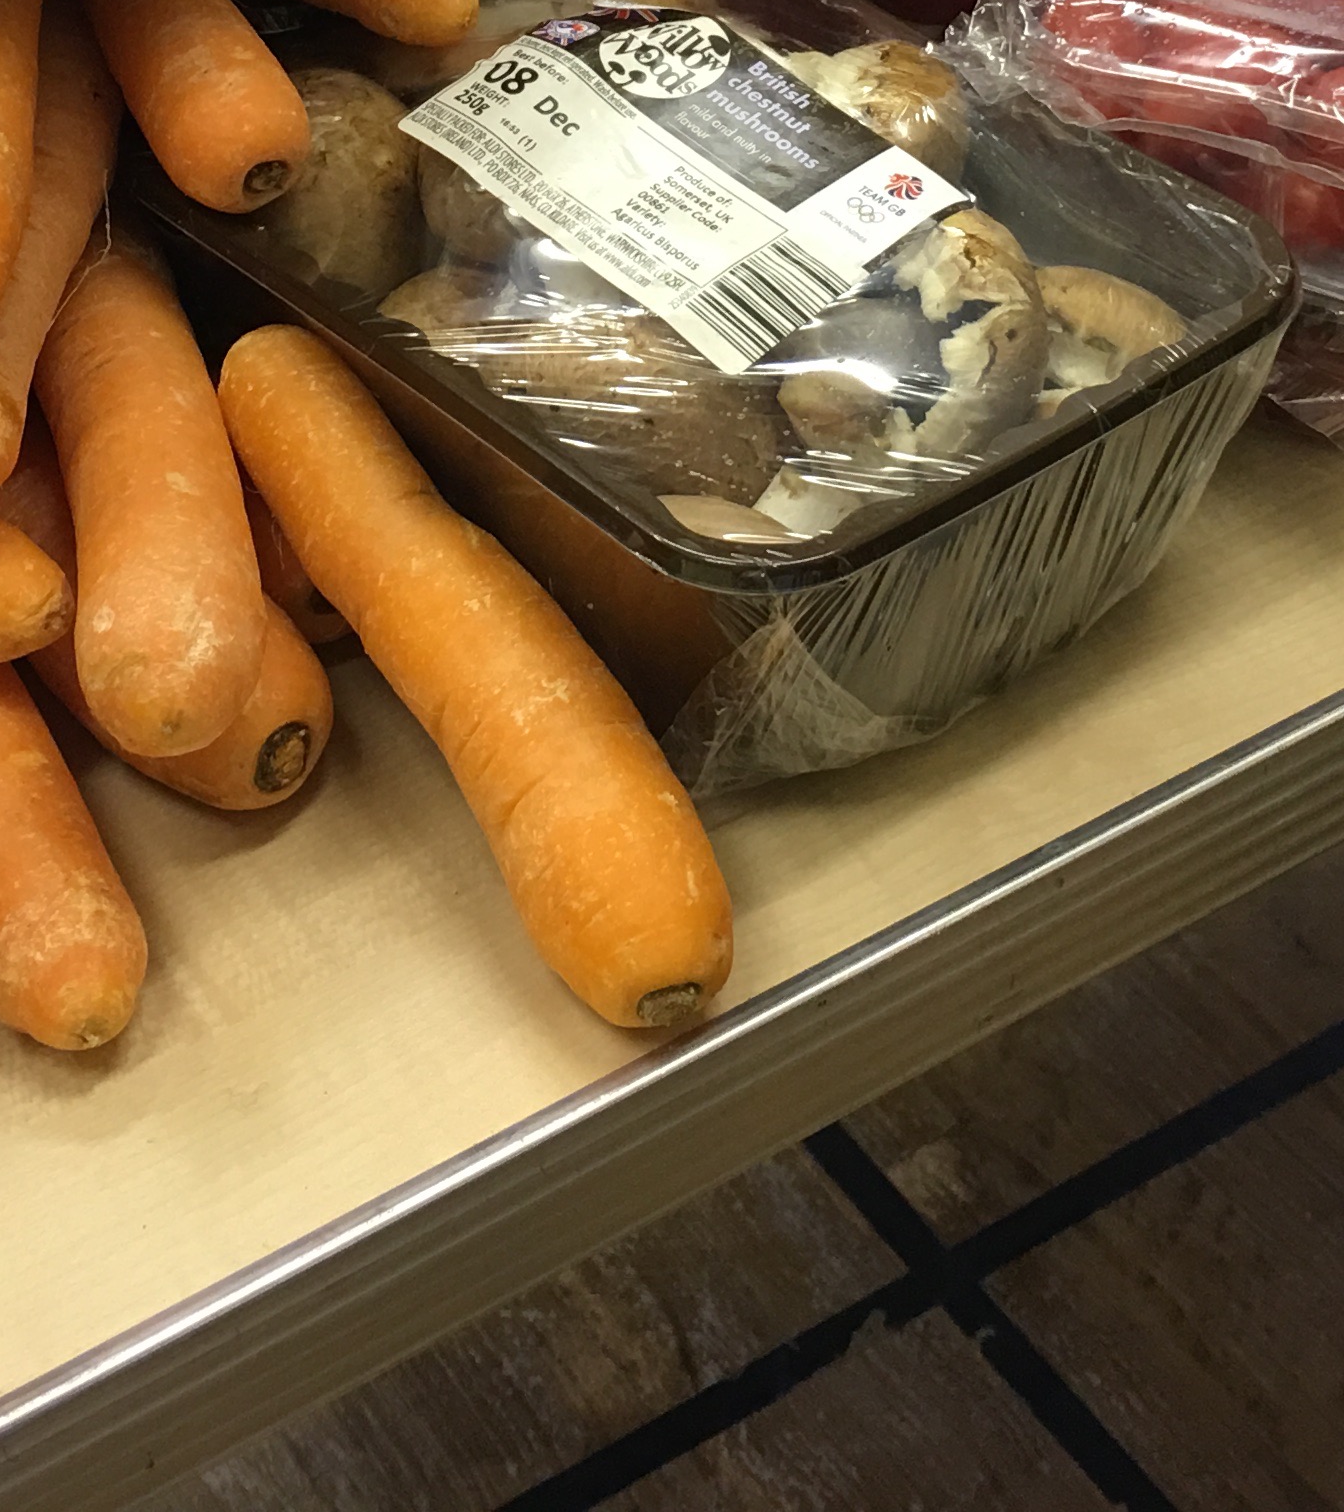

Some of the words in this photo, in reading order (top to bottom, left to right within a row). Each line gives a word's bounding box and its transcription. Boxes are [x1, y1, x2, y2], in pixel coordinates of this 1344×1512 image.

[513, 47, 537, 64] Best
[532, 56, 572, 84] before:
[633, 23, 723, 70] Willow
[469, 80, 512, 109] WEIGHT:
[481, 54, 541, 99] 08
[529, 95, 586, 136] Dec
[725, 74, 814, 136] chestnut
[745, 59, 815, 110] British
[451, 87, 492, 117] 250g
[515, 135, 539, 152] (1)
[672, 110, 714, 140] flavour
[688, 103, 716, 124] mild
[710, 119, 737, 139] and
[730, 134, 763, 158] nutty
[703, 86, 824, 170] mushrooms
[480, 138, 503, 156] ALDI
[494, 151, 527, 176] STORES
[603, 232, 659, 271] WARWICKSHIRE
[635, 191, 671, 214] 00861
[660, 175, 715, 212] Somerset,
[713, 209, 734, 224] UK
[672, 166, 719, 197] Produce
[858, 185, 887, 206] TEAM
[886, 202, 906, 217] GB
[491, 167, 512, 183] BOX
[515, 187, 542, 208] NAAS,
[572, 228, 593, 245] Visit
[601, 251, 654, 289] www.aldi.com
[624, 199, 668, 228] Variety:
[647, 183, 694, 214] Supplier
[689, 210, 724, 233] Code:
[608, 206, 658, 239] Agaricus
[653, 237, 702, 270] Bisporus
